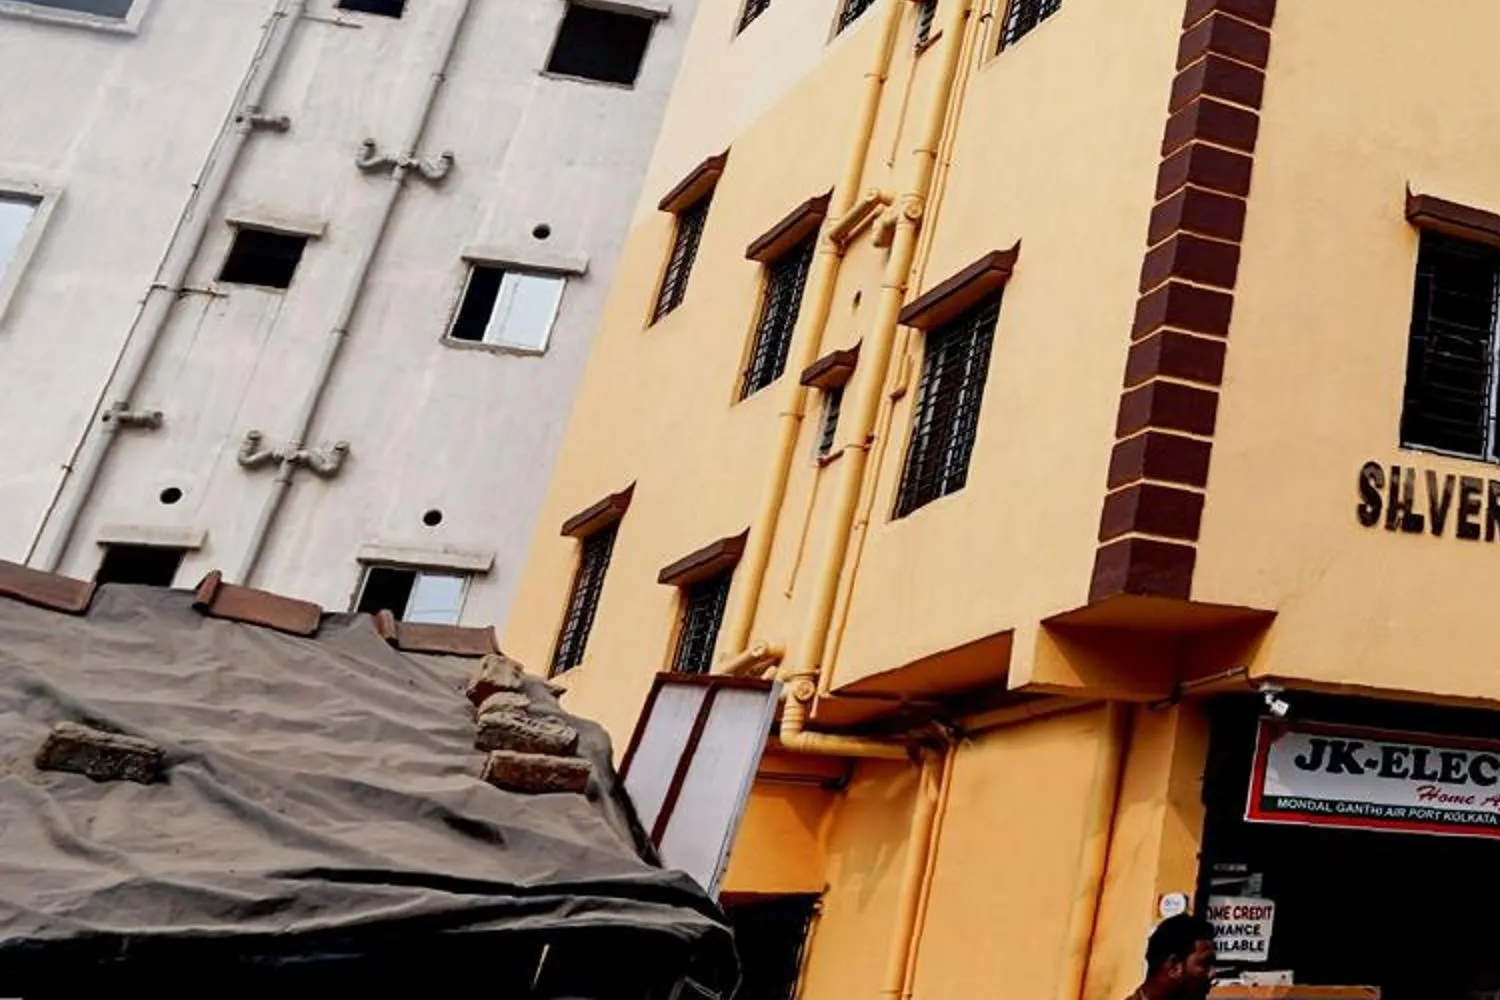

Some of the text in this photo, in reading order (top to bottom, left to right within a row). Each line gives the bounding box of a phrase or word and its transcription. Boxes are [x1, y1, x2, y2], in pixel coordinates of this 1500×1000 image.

[1415, 784, 1476, 805] Home
[1276, 798, 1334, 813] MONDAL
[1385, 807, 1406, 818] AIR
[1407, 808, 1441, 821] PORT
[1443, 811, 1497, 825] KOLKATA
[1207, 905, 1273, 921] OME CREDIT
[1215, 923, 1261, 936] NANCE
[1217, 939, 1265, 952] ILABLE
